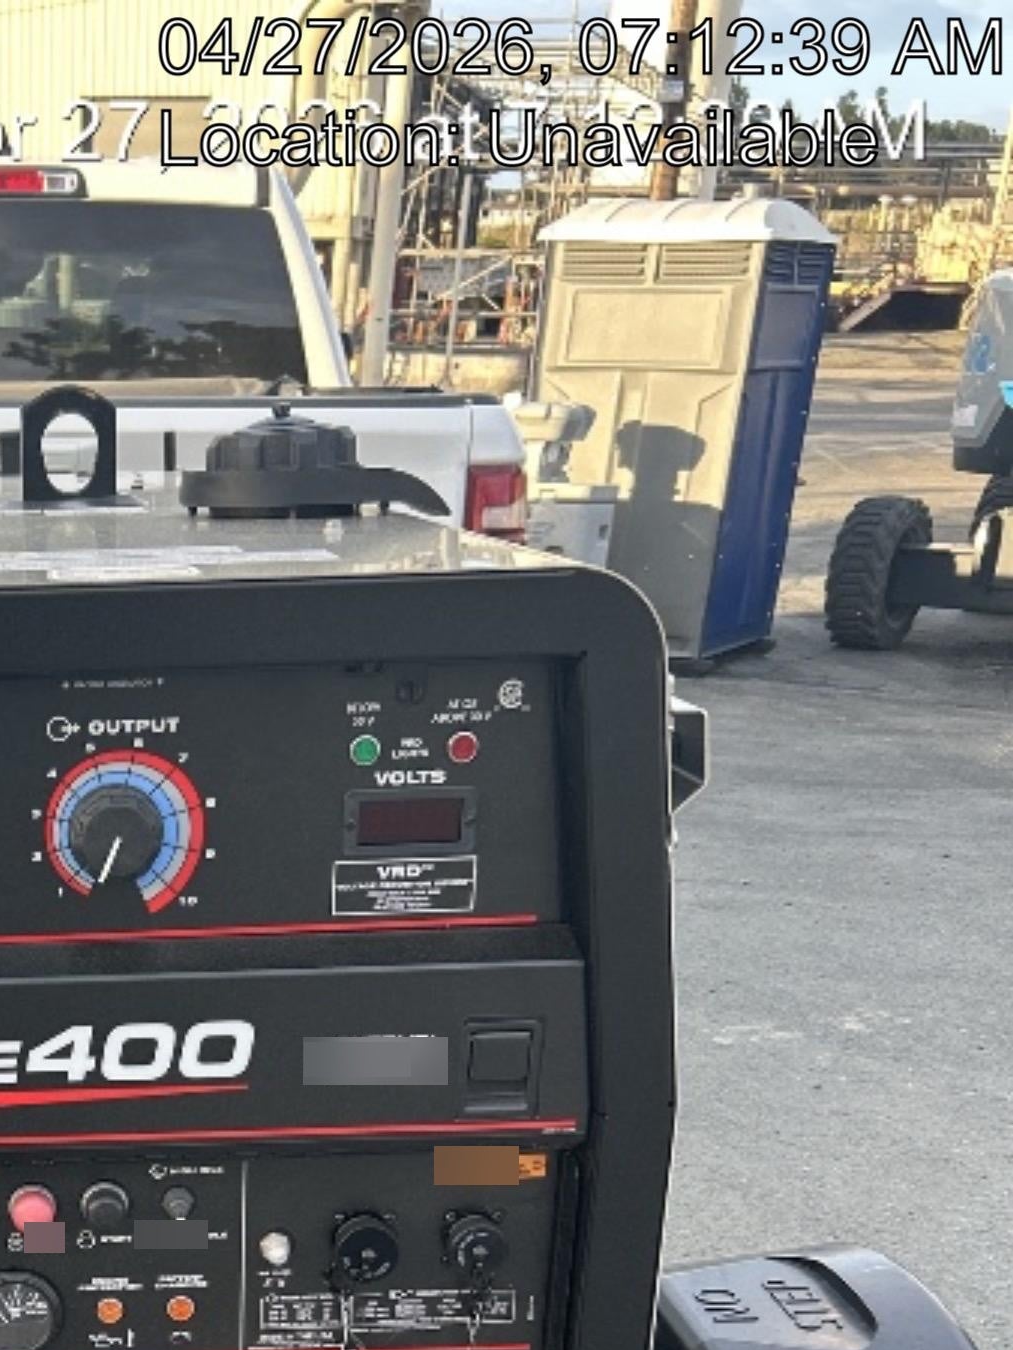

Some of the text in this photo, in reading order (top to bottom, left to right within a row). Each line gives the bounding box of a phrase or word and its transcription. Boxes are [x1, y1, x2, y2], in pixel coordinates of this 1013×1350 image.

[89, 716, 180, 736] OUTPUT
[374, 769, 448, 786] VOLTS
[694, 1289, 759, 1324] NO
[761, 1279, 844, 1331] STEP
